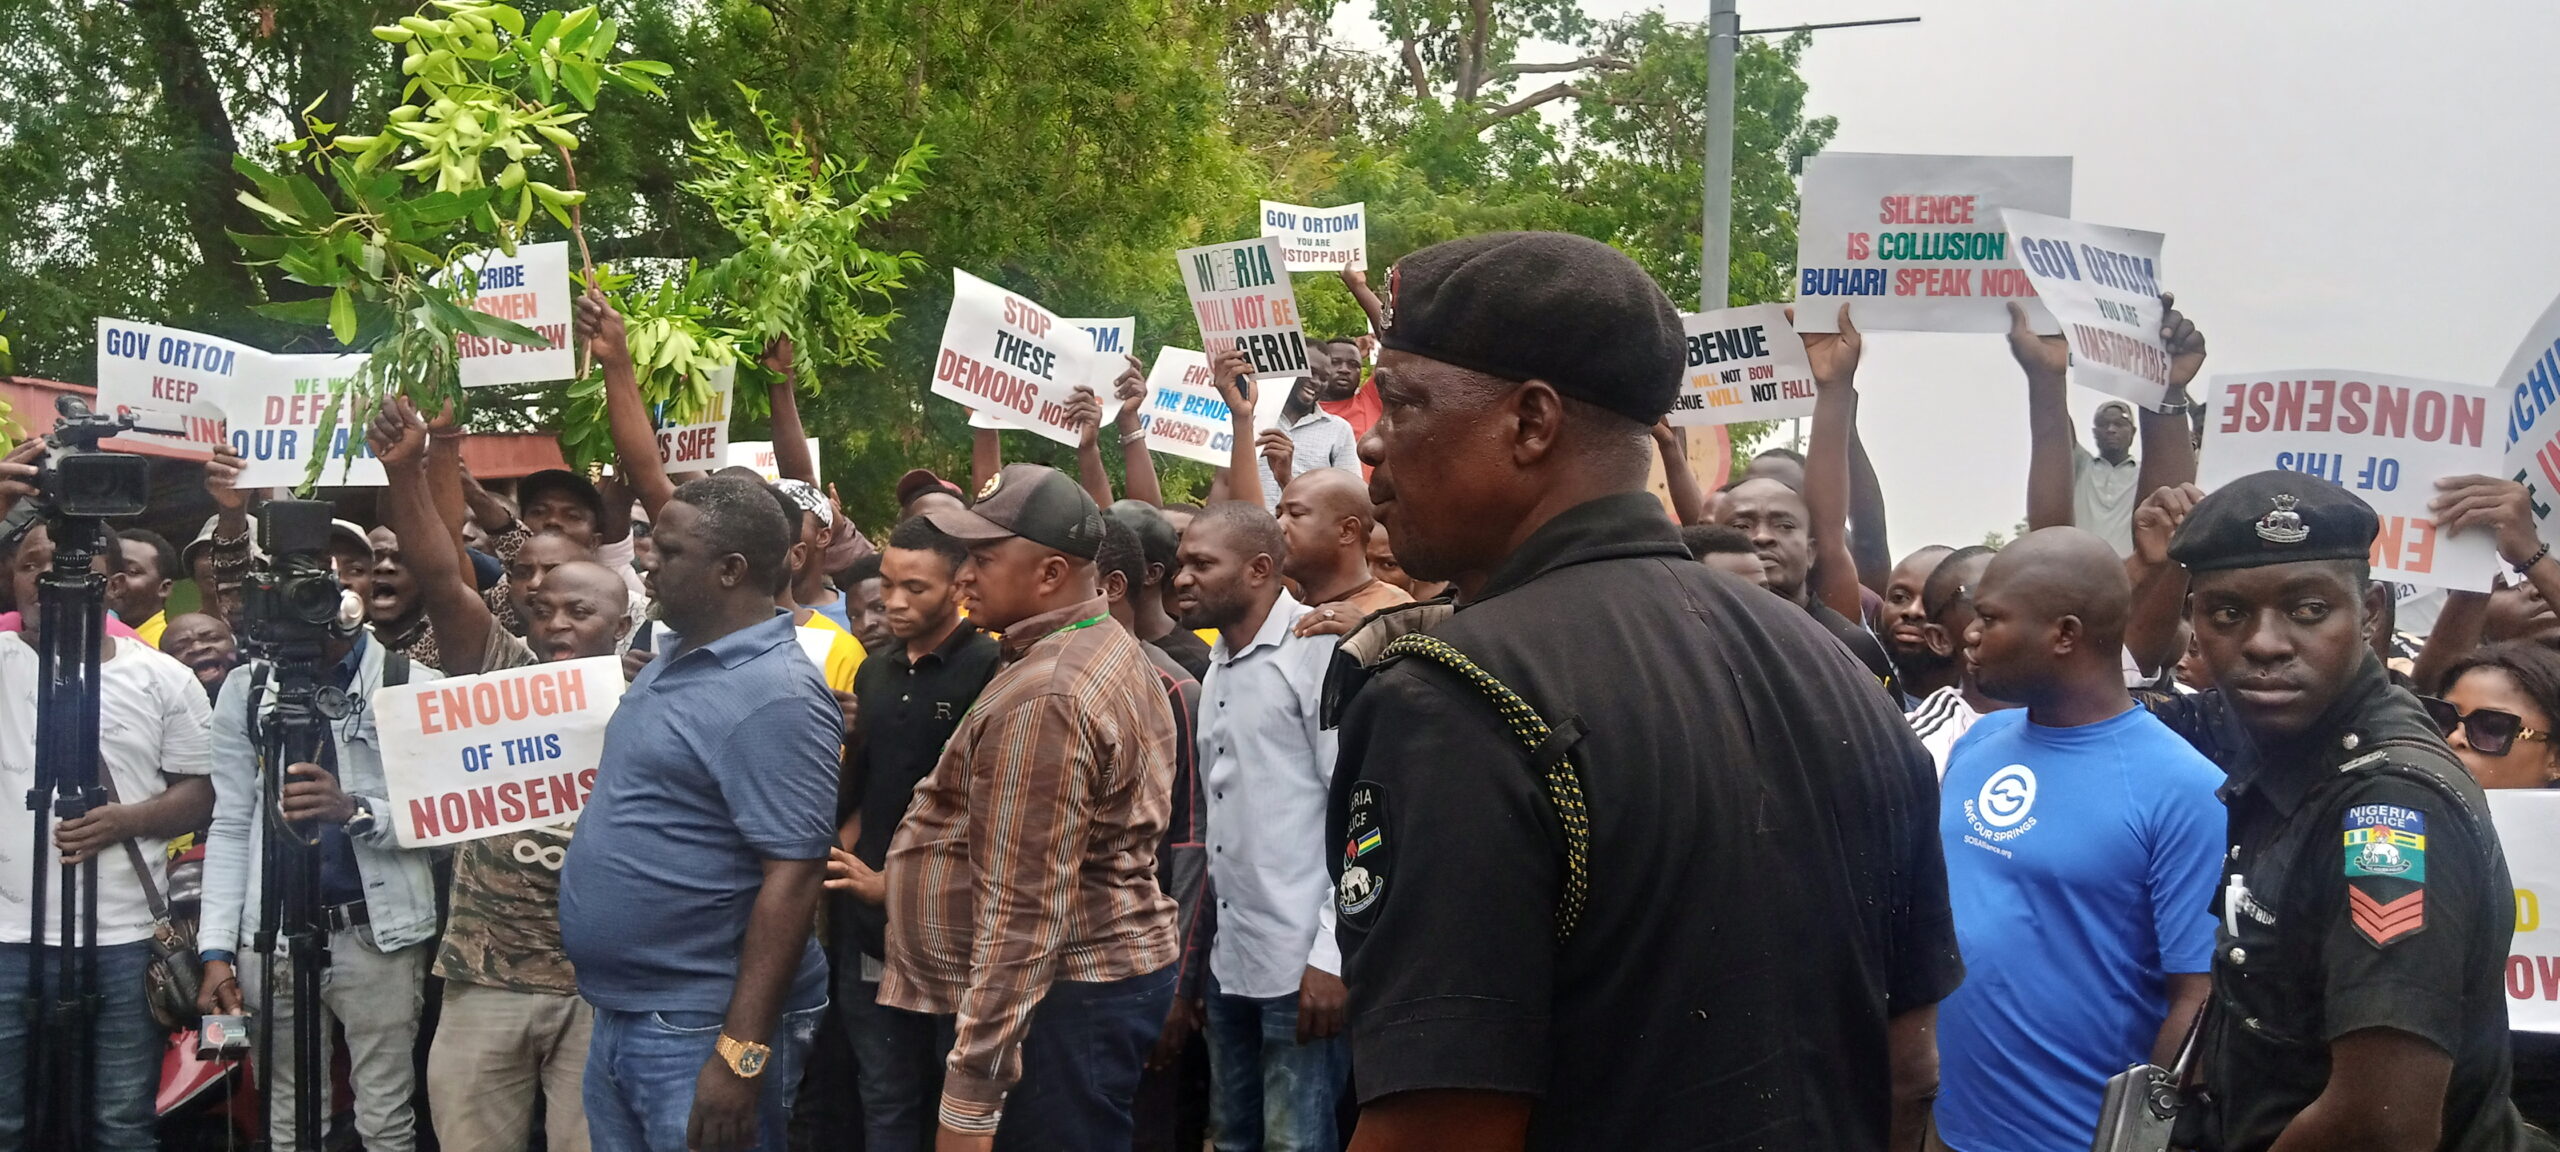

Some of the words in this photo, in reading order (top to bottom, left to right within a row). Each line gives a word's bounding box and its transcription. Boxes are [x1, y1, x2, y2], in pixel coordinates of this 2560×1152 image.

[1266, 209, 1296, 229] GOV
[1302, 213, 1359, 233] ORTOM
[1879, 195, 1977, 225] SILENCE
[1281, 246, 1361, 264] NSTOPPABLE
[1296, 237, 1313, 247] YOU
[1315, 238, 1331, 247] ARE
[1847, 232, 1870, 261] IS
[1878, 232, 2005, 261] COLLUSION
[456, 264, 525, 291] CRIBE
[1193, 244, 1276, 293] NIGERIA
[1801, 268, 1887, 297] BUHARI
[1894, 268, 1971, 297] SPEAK
[2021, 236, 2081, 281] GOV
[2080, 243, 2161, 300] ORTOM
[472, 293, 537, 321] SMEN
[1004, 296, 1052, 339] STOP
[1196, 300, 1230, 332] WILL
[1232, 294, 1267, 330] NOT
[1271, 299, 1294, 326] BE
[2095, 297, 2120, 322] YOU
[2119, 303, 2141, 328] ARE
[107, 328, 151, 361] GOV
[993, 329, 1056, 380] THESE
[1687, 325, 1770, 368] BENUE
[2073, 323, 2168, 386] UNSTOPPABLE
[152, 376, 198, 404] KEEP
[294, 379, 320, 394] WE
[937, 348, 1039, 415] DEMONS
[1691, 373, 1718, 389] WILL
[1720, 369, 1741, 384] NOT
[1748, 365, 1773, 381] BOW
[1154, 387, 1182, 411] THE
[1182, 394, 1230, 422] BENUE
[1671, 394, 1704, 412] ENUE
[1706, 387, 1743, 407] WILL
[1751, 382, 1778, 403] NOT
[1782, 379, 1815, 400] FALL
[2220, 379, 2486, 448] NONSENSE
[232, 429, 297, 460] OUR
[676, 427, 717, 462] SAFE
[1151, 416, 1210, 447] SACRED
[1210, 430, 1233, 453] CO
[2357, 456, 2400, 492] OF
[416, 669, 587, 735] ENOUGH
[461, 744, 493, 772] OF
[502, 734, 562, 767] THIS
[409, 768, 597, 840] NONSENS
[1964, 799, 1978, 825] SAVE
[1973, 821, 1993, 840] OUR
[1993, 816, 2037, 841] SPRINGS
[2349, 805, 2418, 823] NIGERIA
[2357, 815, 2406, 829] POLICE
